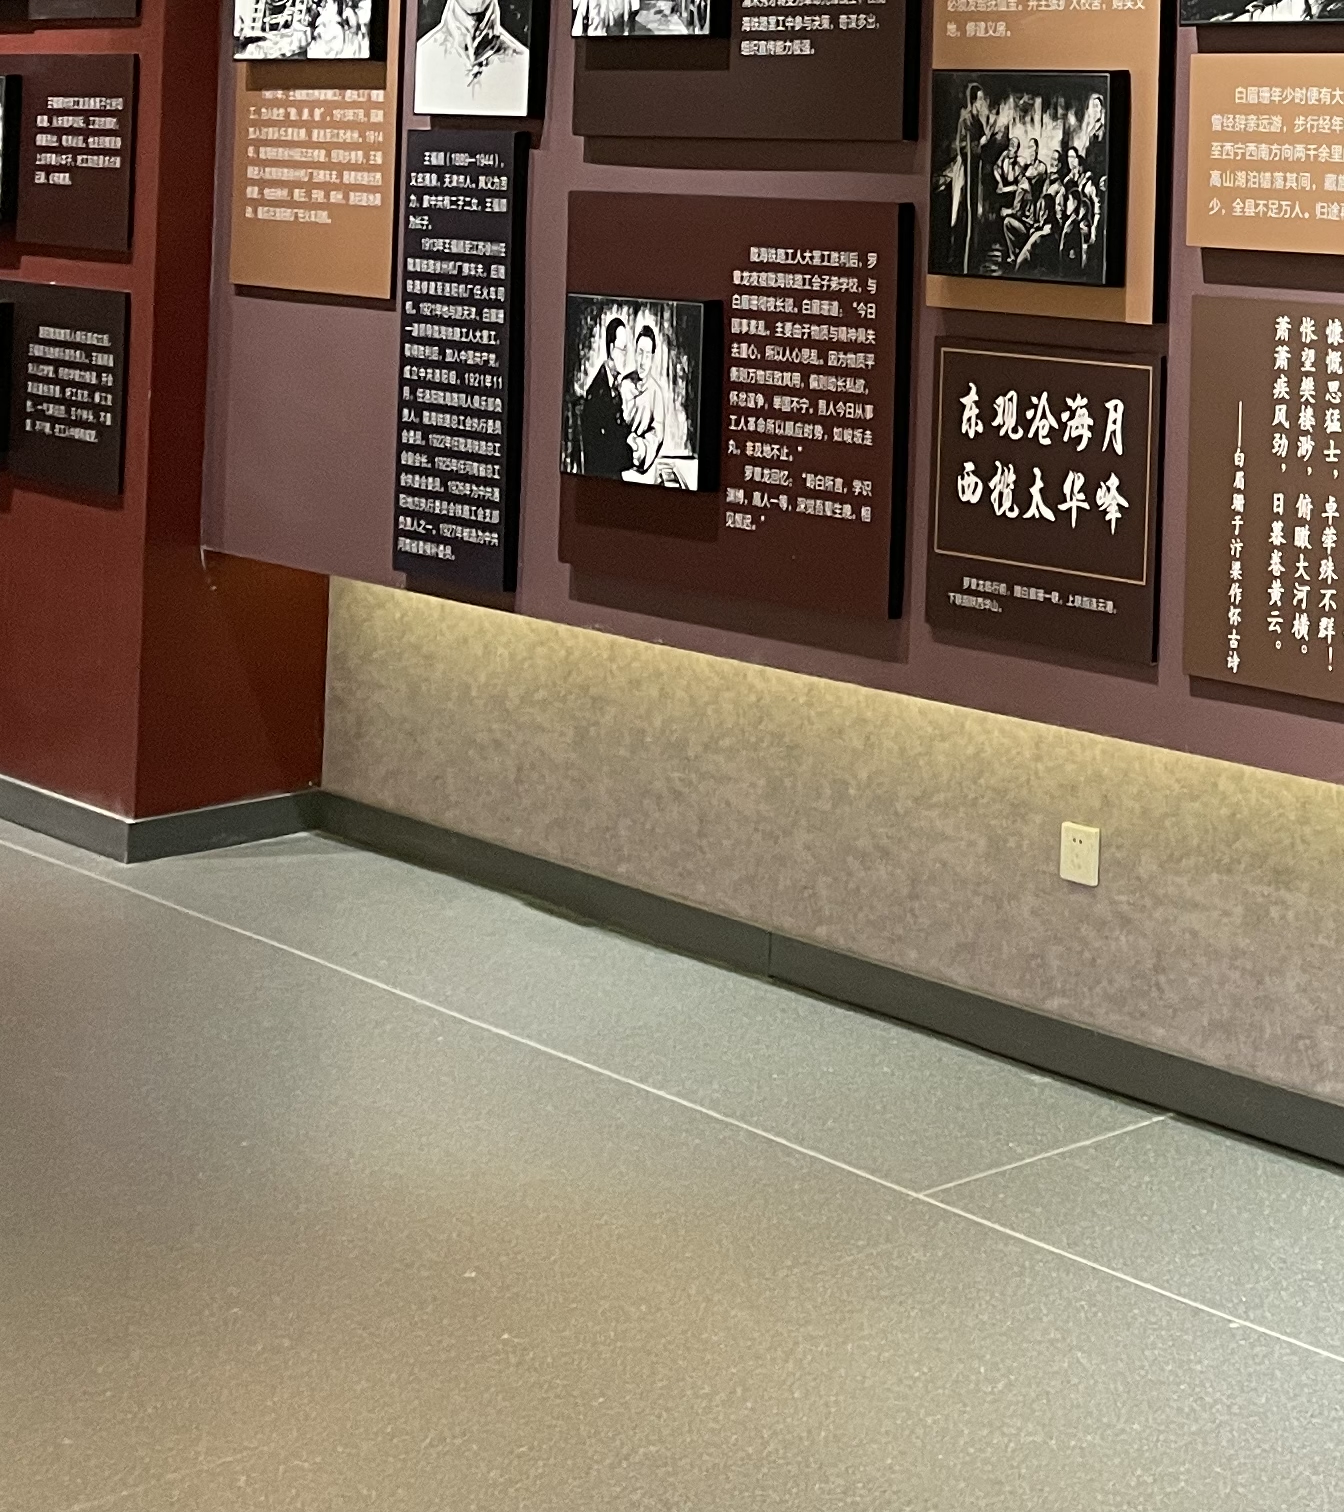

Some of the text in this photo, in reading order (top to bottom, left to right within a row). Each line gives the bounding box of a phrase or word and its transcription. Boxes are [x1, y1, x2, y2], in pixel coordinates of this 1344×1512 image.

[959, 382, 1125, 456] 东观沧海月
[1323, 318, 1344, 479] 慷慨思猛士，
[1267, 316, 1292, 650] 萧萧疾风劲， 日暮卷黄云。
[1291, 493, 1313, 654] 俯瞰大河横。
